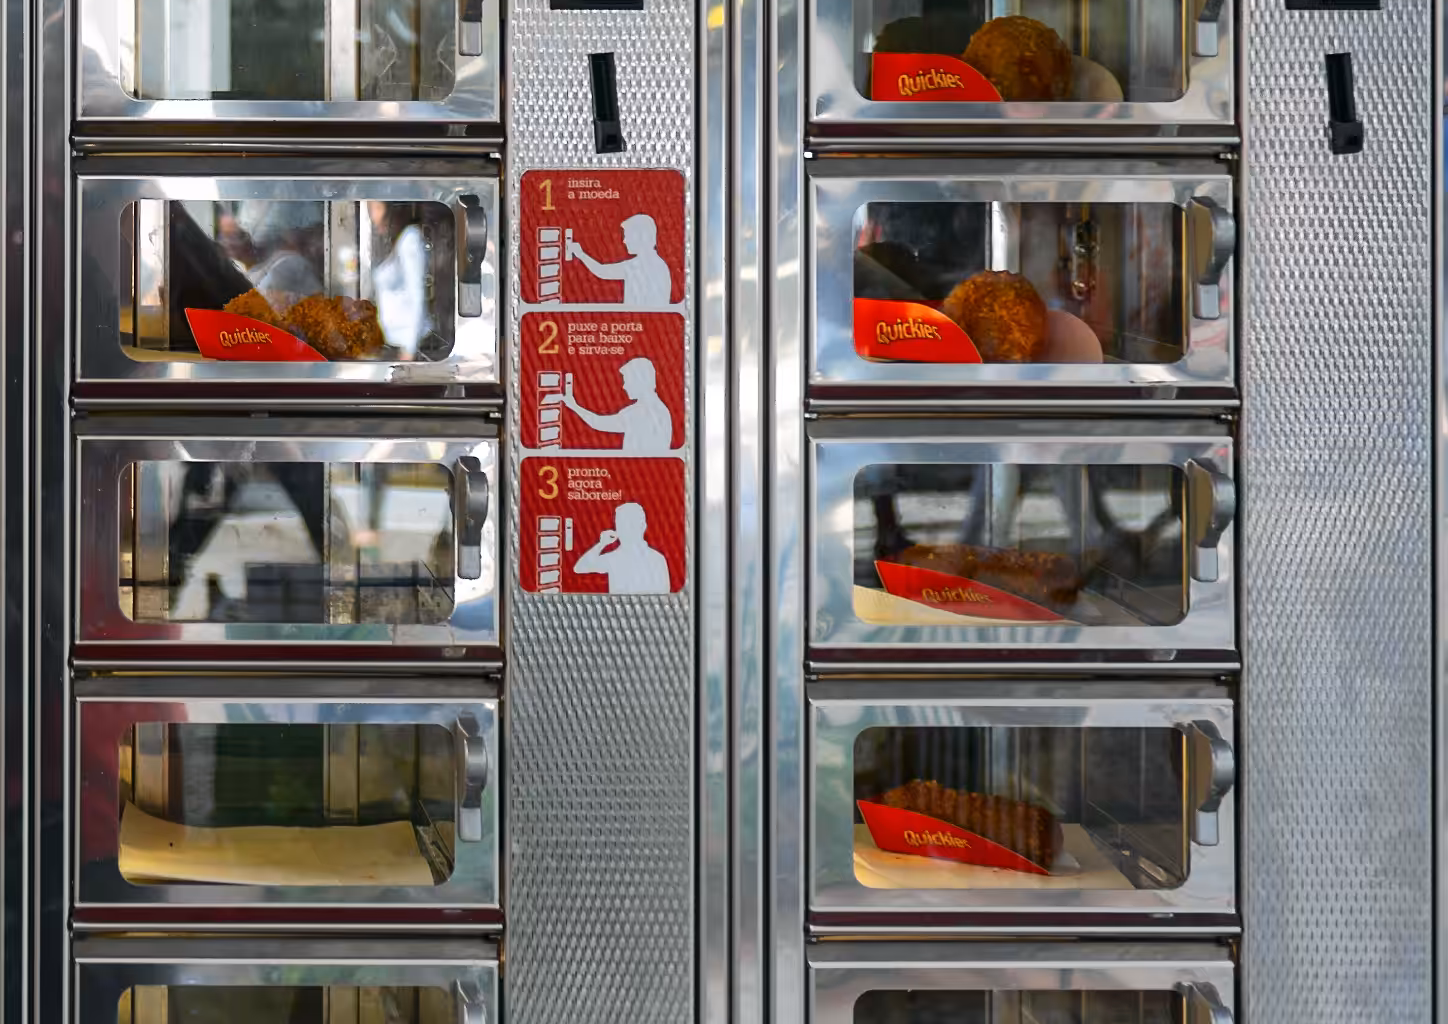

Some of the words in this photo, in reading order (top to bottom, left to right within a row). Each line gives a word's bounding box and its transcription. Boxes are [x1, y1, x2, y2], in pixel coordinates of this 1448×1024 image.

[898, 68, 964, 96] Quickies
[568, 177, 601, 188] insira
[539, 179, 556, 211] 1
[567, 190, 575, 199] a
[579, 188, 620, 199] moeda
[567, 322, 597, 333] puxe
[601, 322, 608, 331] a
[611, 321, 643, 333] porta
[876, 318, 942, 345] Quickies
[219, 327, 272, 347] Quickies
[538, 321, 559, 354] 2
[567, 334, 595, 345] para
[599, 332, 633, 343] baixo
[568, 346, 575, 354] e
[579, 343, 624, 355] sirva-se
[567, 467, 611, 479] pronto,
[538, 465, 558, 500] 3
[567, 479, 602, 490] agora
[567, 489, 622, 500] saboreie!
[904, 830, 971, 847] Quickies
